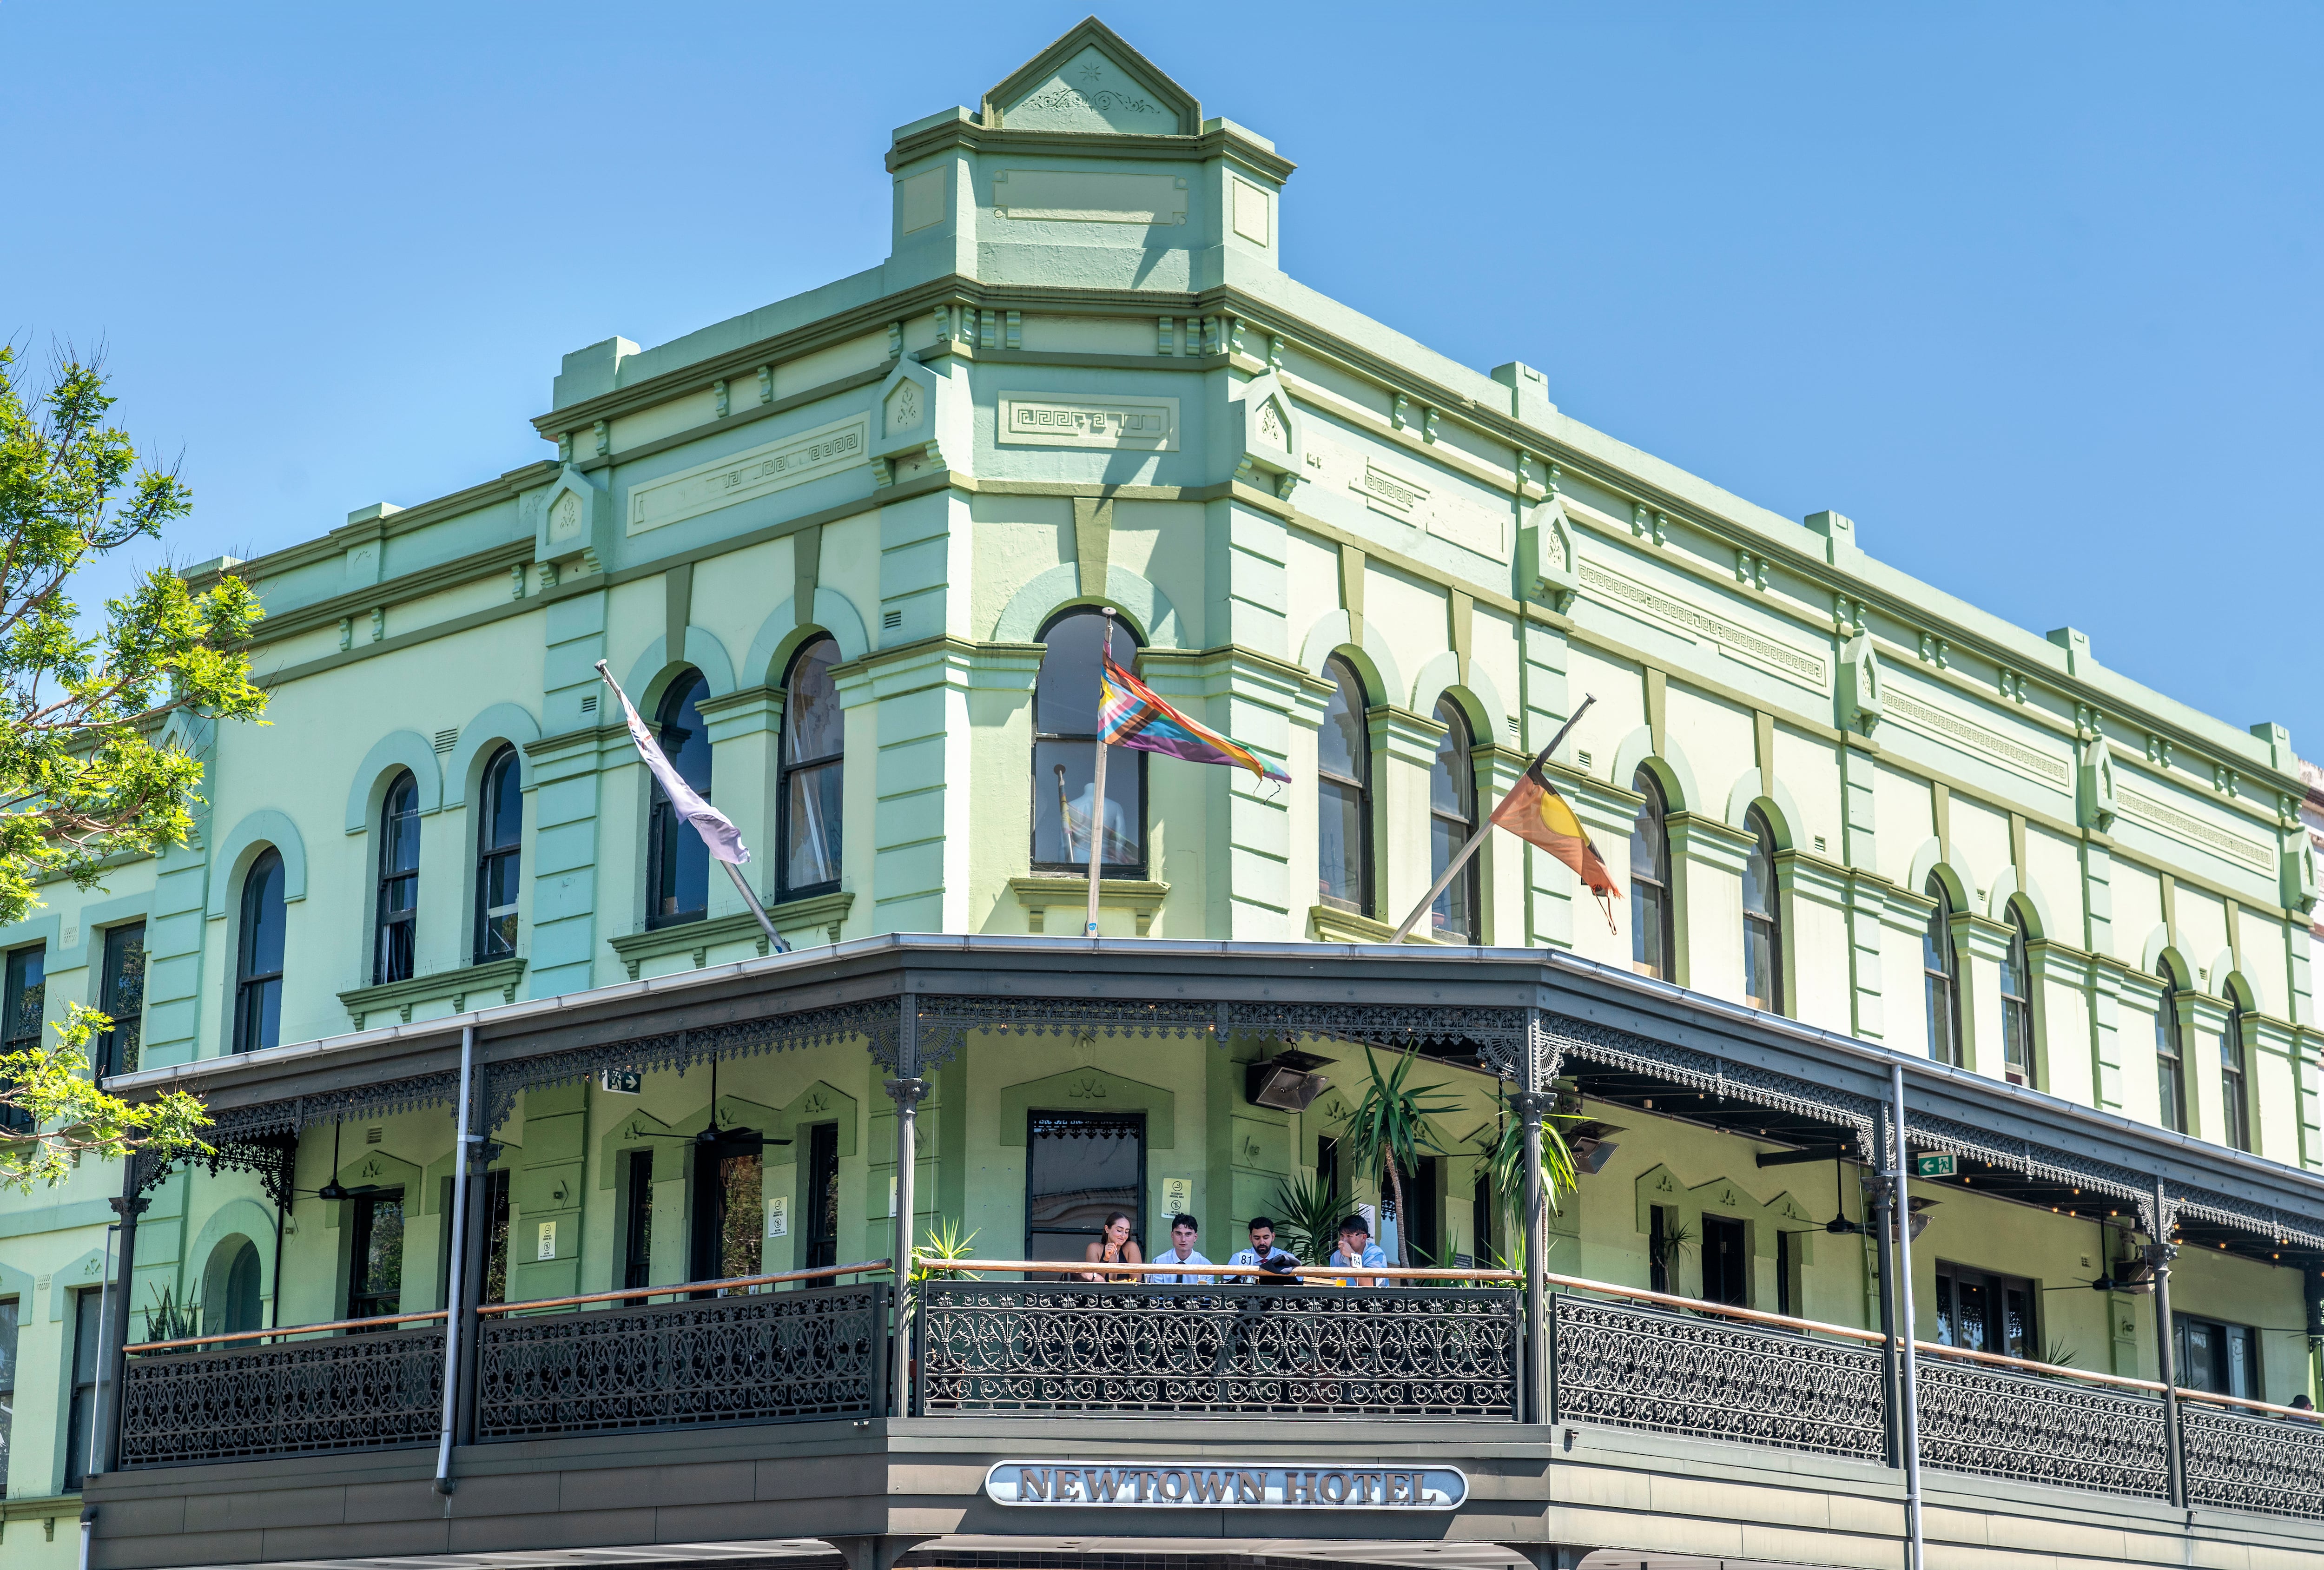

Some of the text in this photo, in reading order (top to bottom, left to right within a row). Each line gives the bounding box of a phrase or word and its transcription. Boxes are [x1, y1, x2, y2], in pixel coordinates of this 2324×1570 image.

[1241, 1255, 1252, 1265] 81
[1353, 1256, 1360, 1266] 64
[1019, 1469, 1437, 1502] NEWTOWN HOTEL
